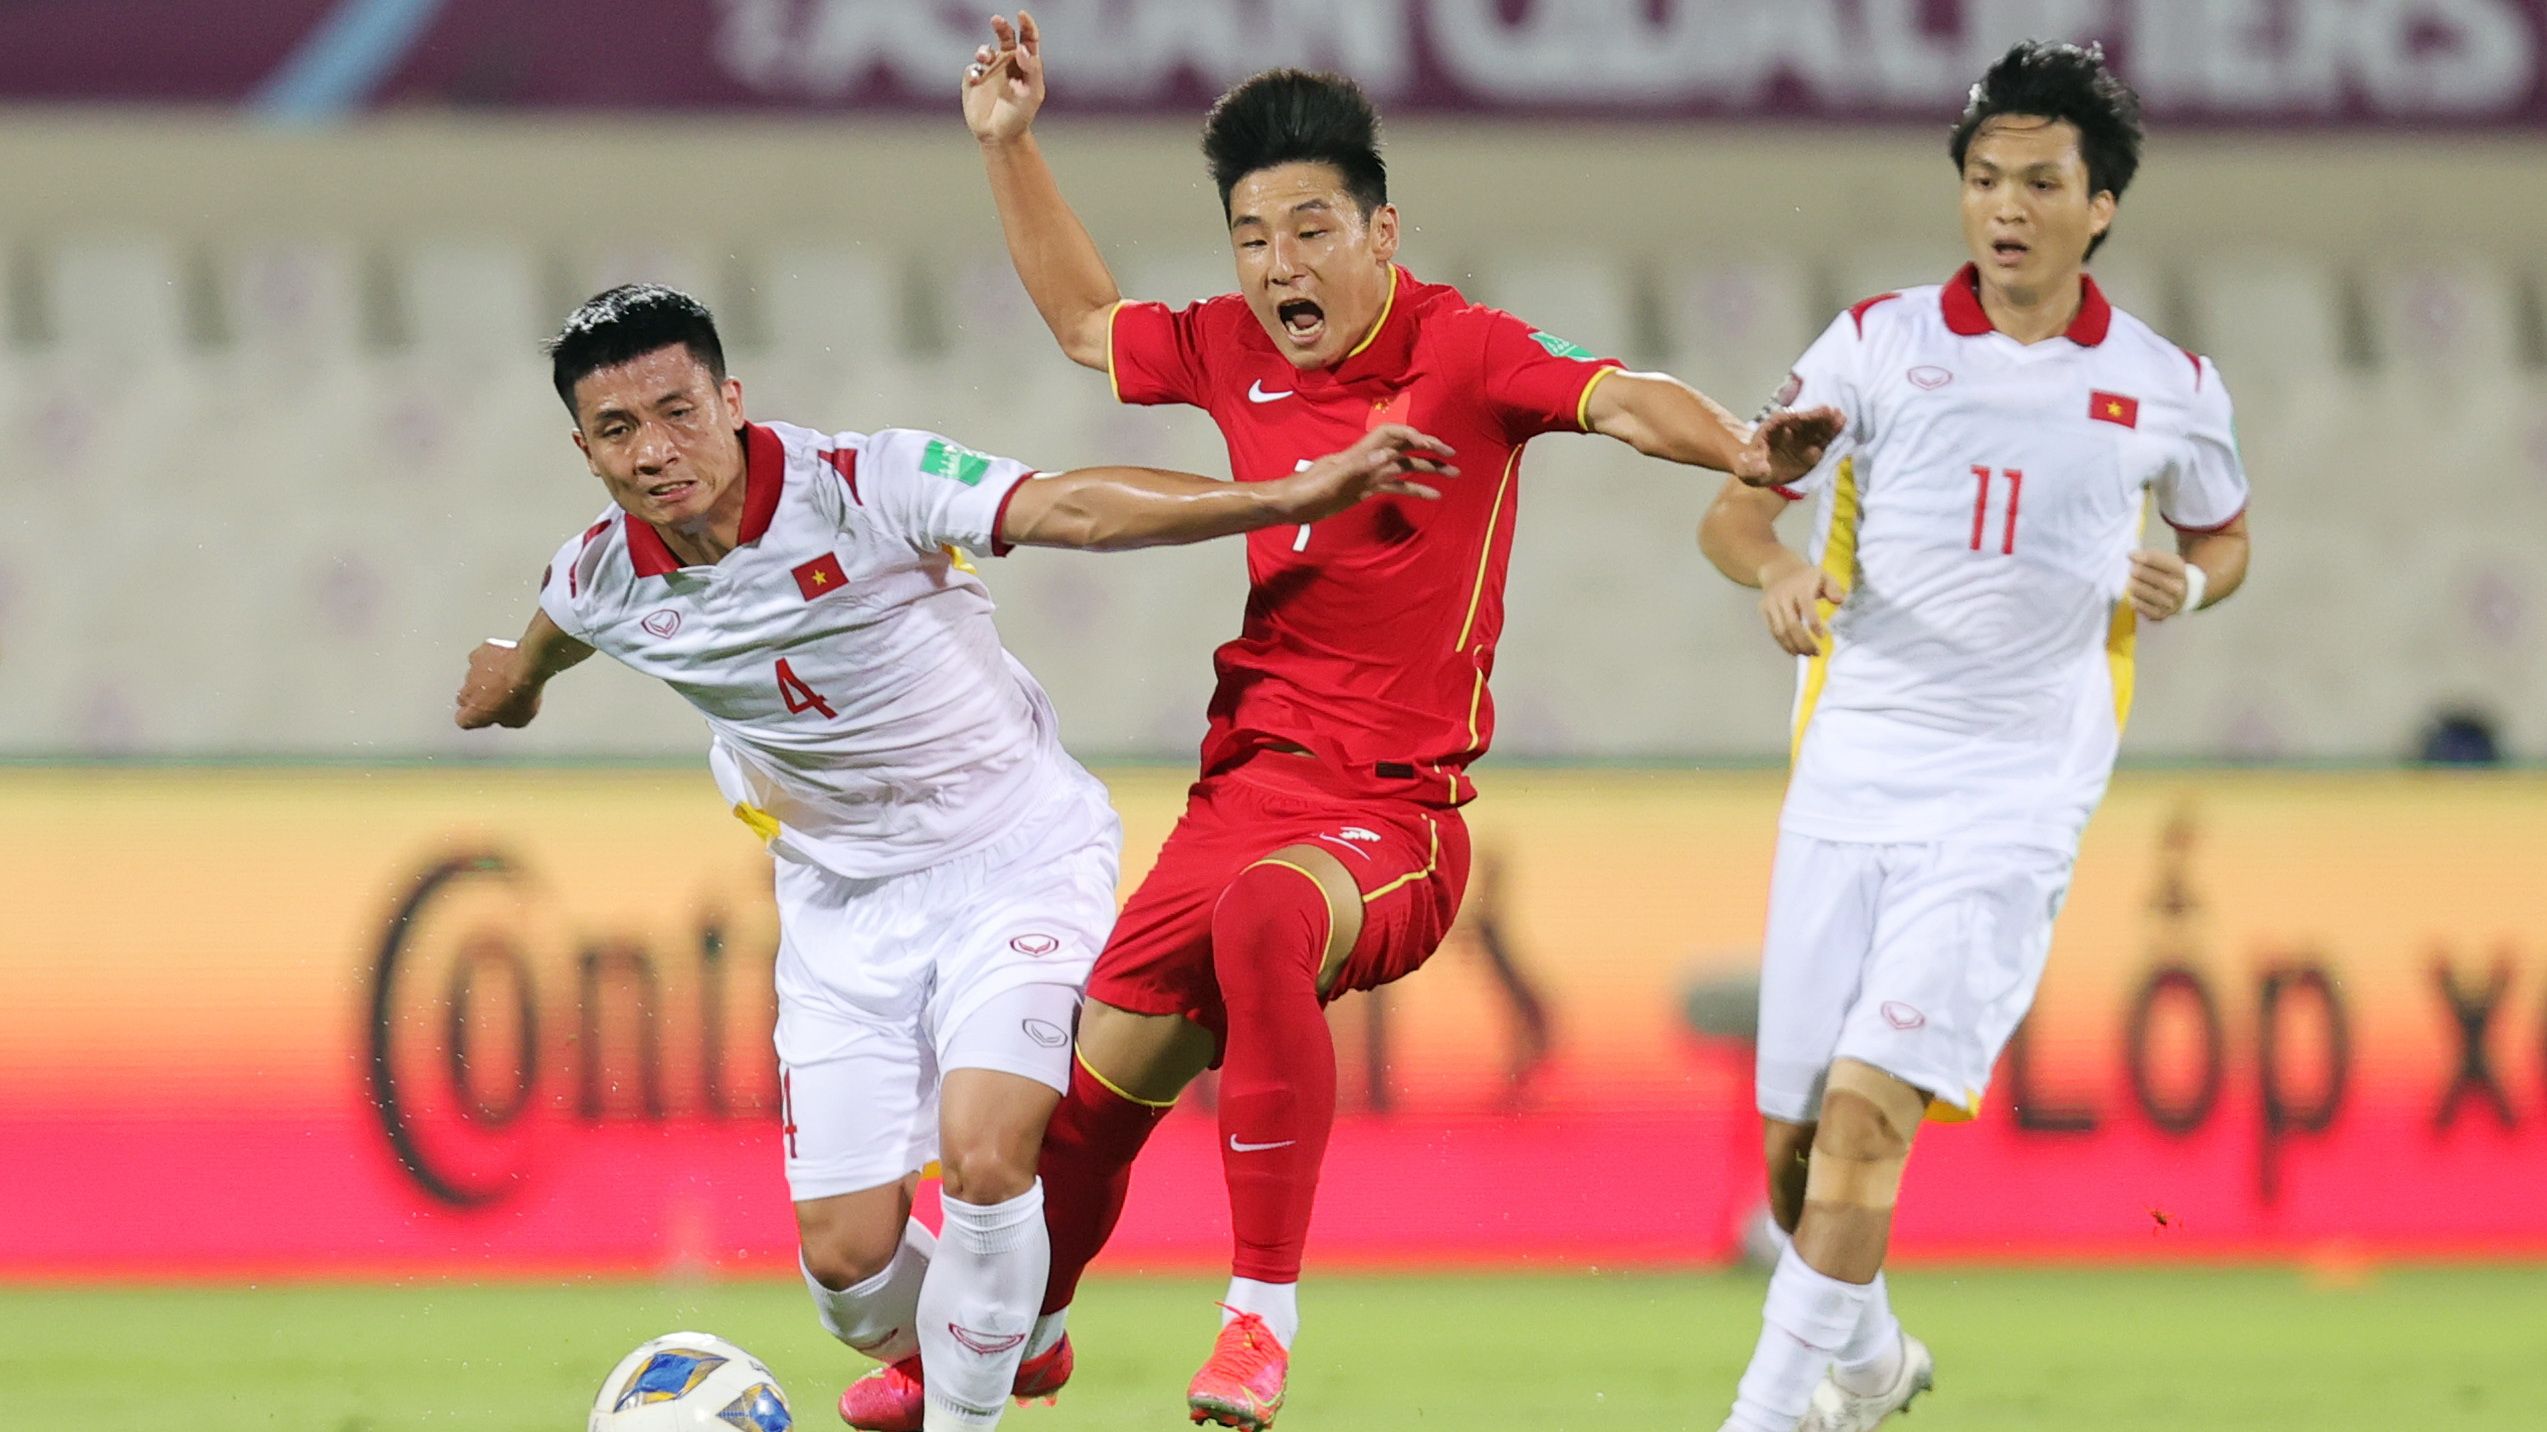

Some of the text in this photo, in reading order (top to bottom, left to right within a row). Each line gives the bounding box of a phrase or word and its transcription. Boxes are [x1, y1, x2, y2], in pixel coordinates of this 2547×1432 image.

[1427, 0, 2536, 98] QUALIERS
[1970, 464, 2022, 555] 11
[775, 657, 838, 720] 4
